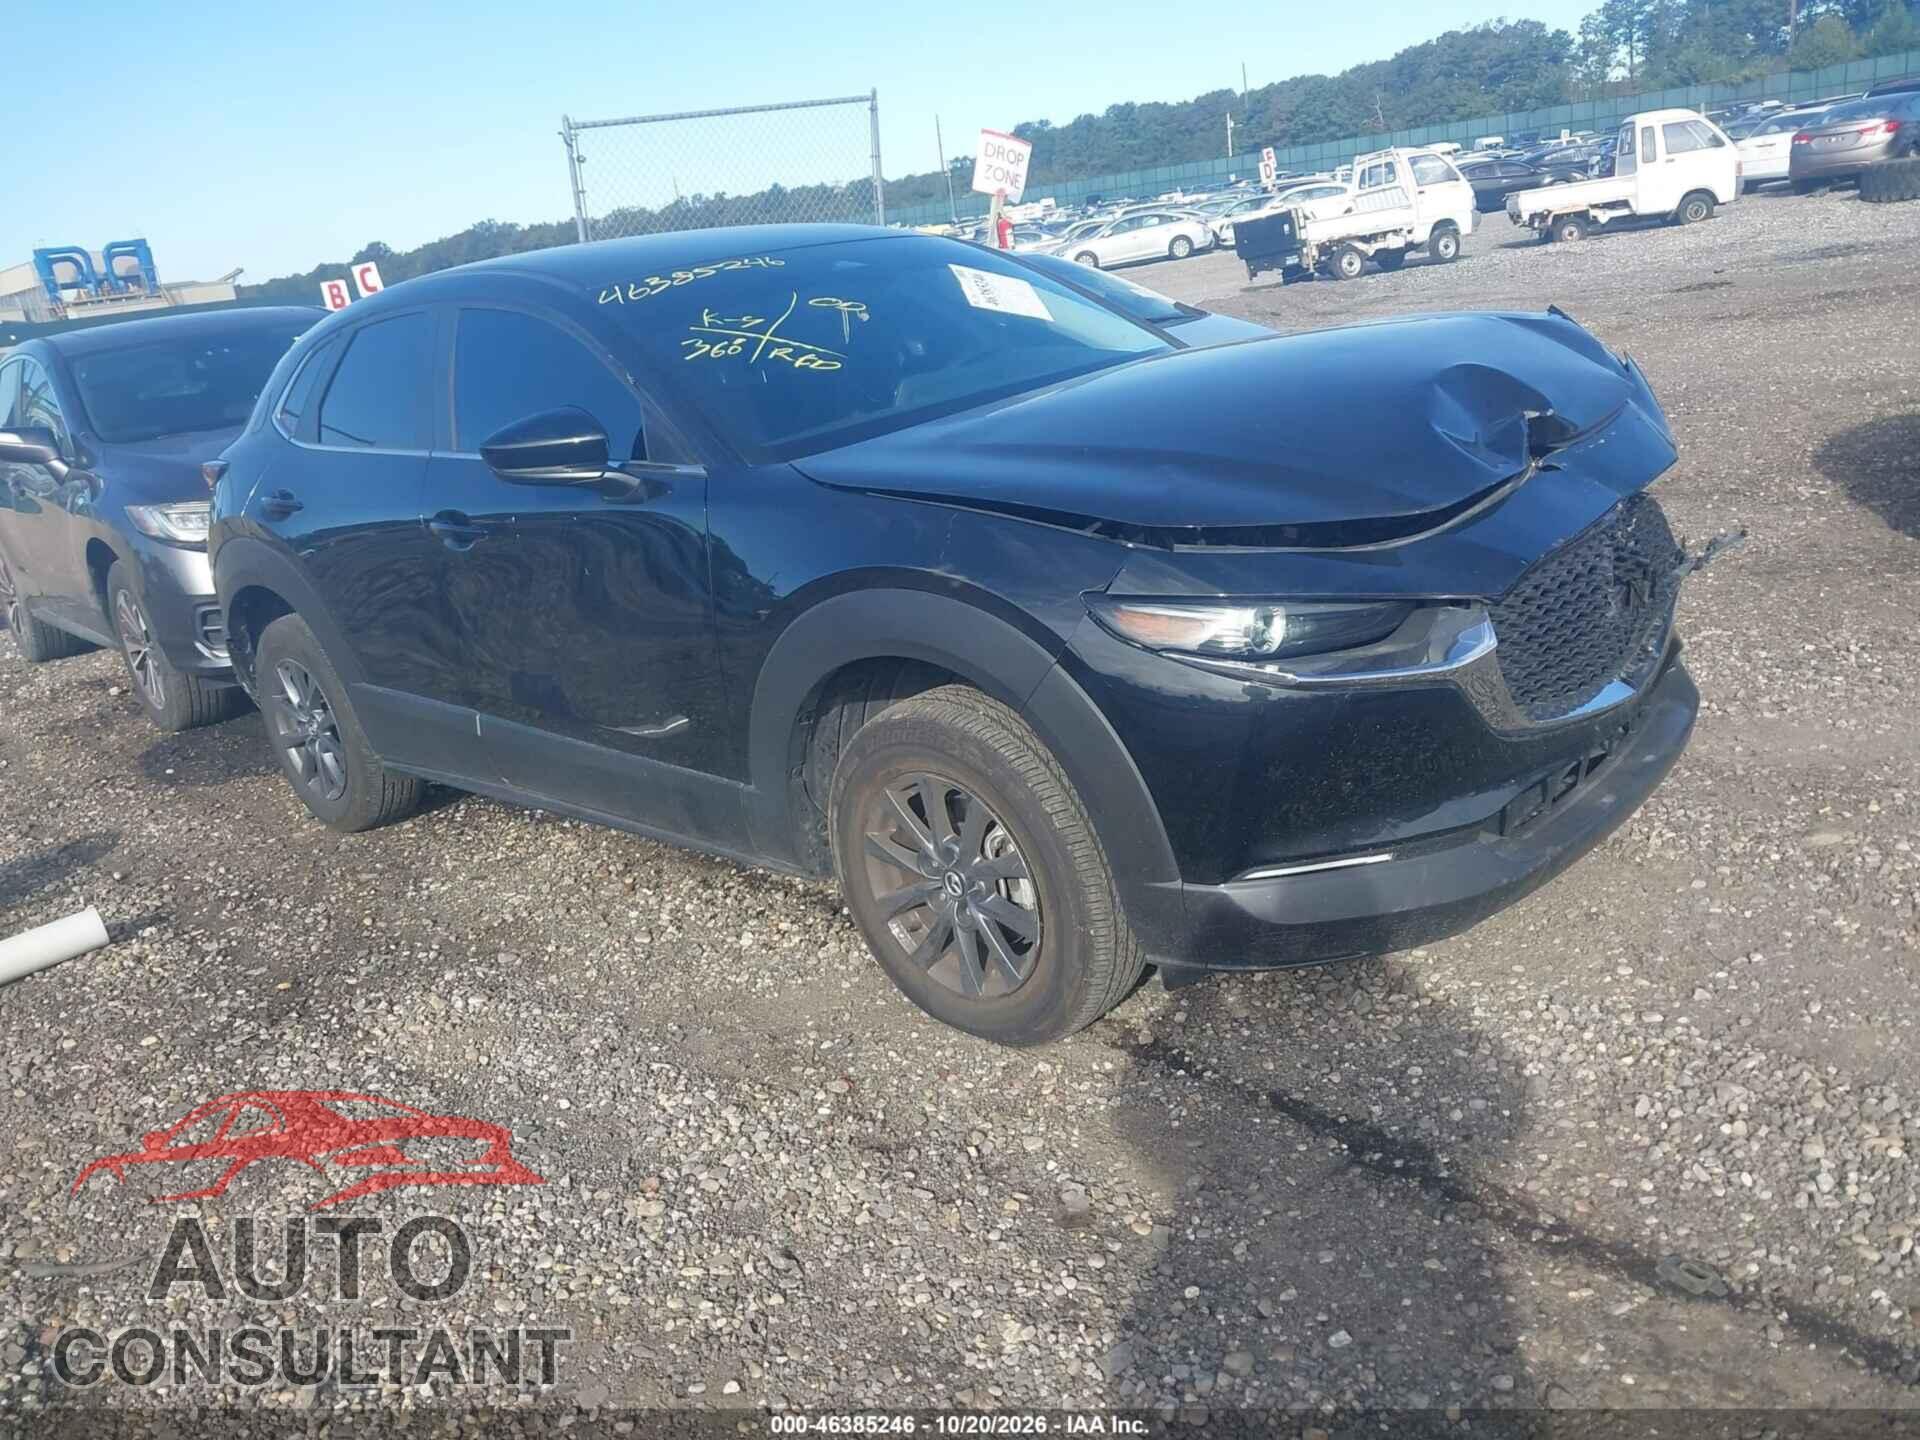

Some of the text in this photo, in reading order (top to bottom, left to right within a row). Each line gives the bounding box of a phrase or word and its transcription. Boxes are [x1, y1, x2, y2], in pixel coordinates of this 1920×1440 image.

[984, 141, 1024, 167] DROP
[984, 163, 1022, 190] ZONE
[1263, 163, 1272, 179] D
[359, 266, 378, 293] C
[598, 256, 785, 304] 46385246
[327, 283, 346, 309] B
